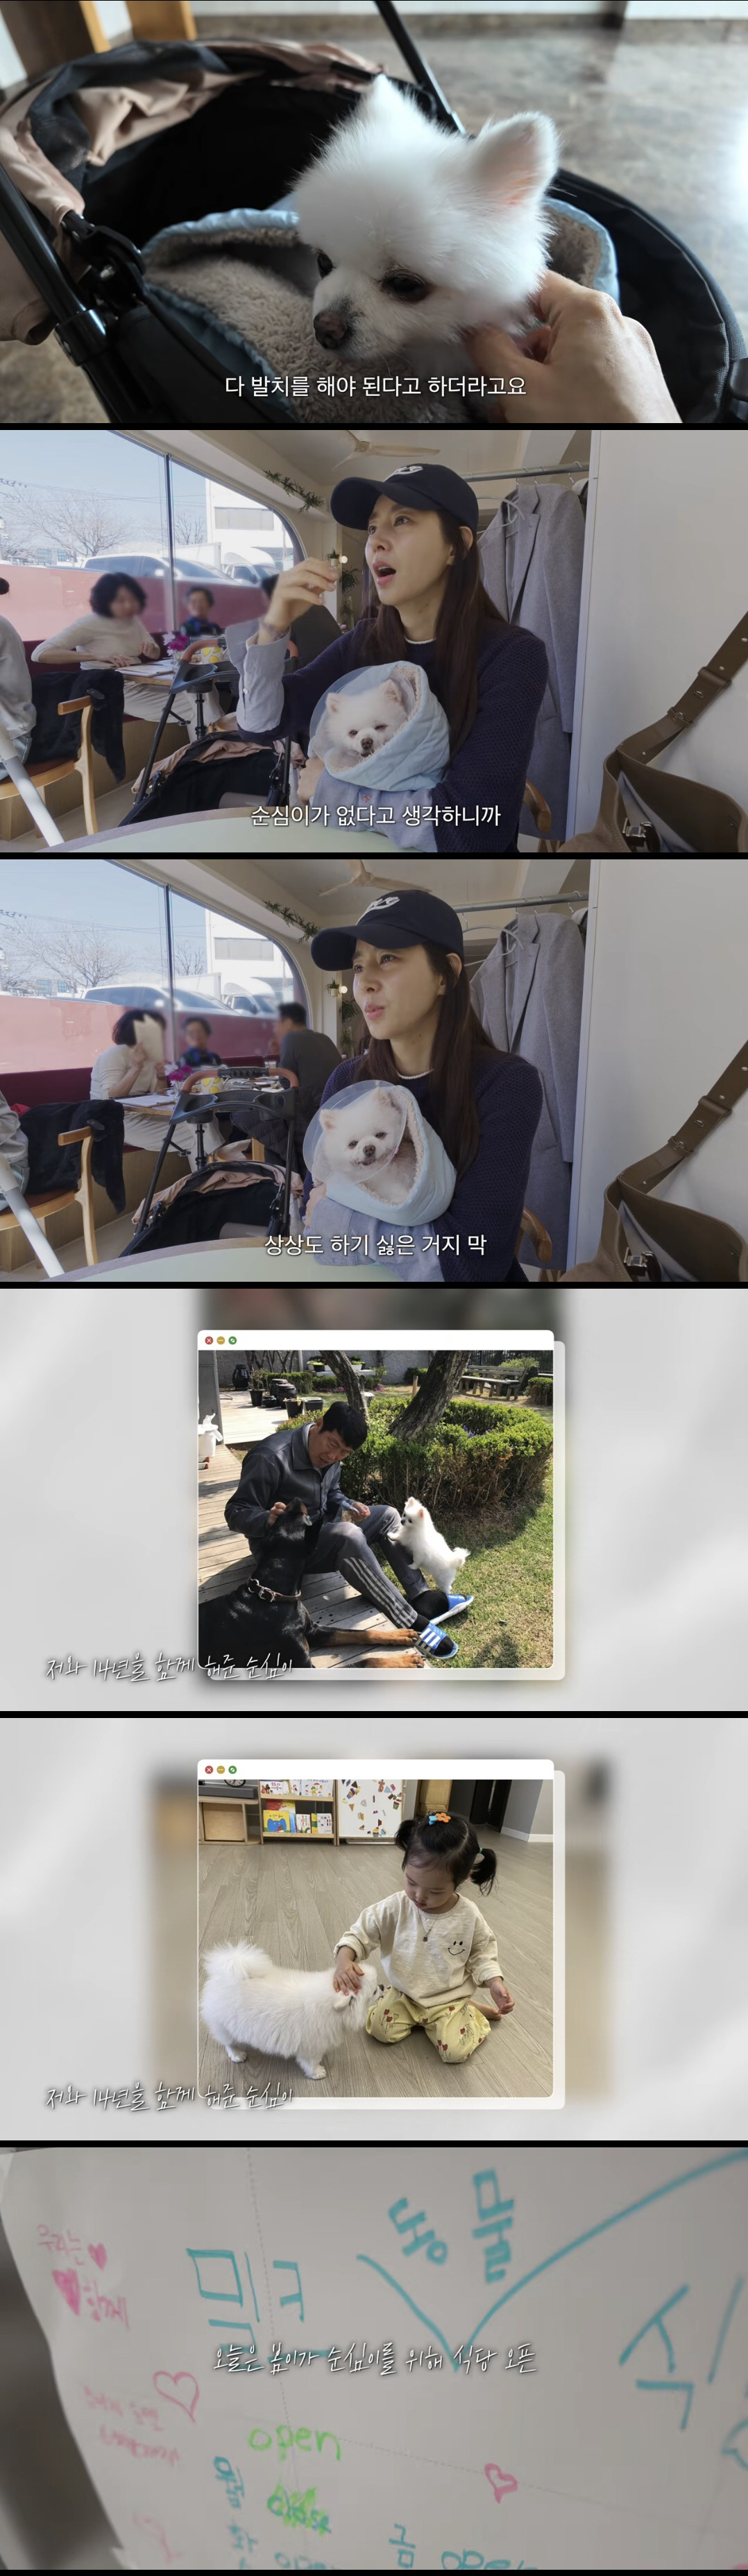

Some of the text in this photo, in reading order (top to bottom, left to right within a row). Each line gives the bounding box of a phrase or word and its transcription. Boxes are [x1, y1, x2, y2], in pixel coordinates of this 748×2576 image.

[37, 2224, 85, 2267] 우리는
[388, 2167, 515, 2284] 동물
[248, 2425, 342, 2461] open
[389, 2523, 416, 2568] 금
[441, 2549, 538, 2570] ope
